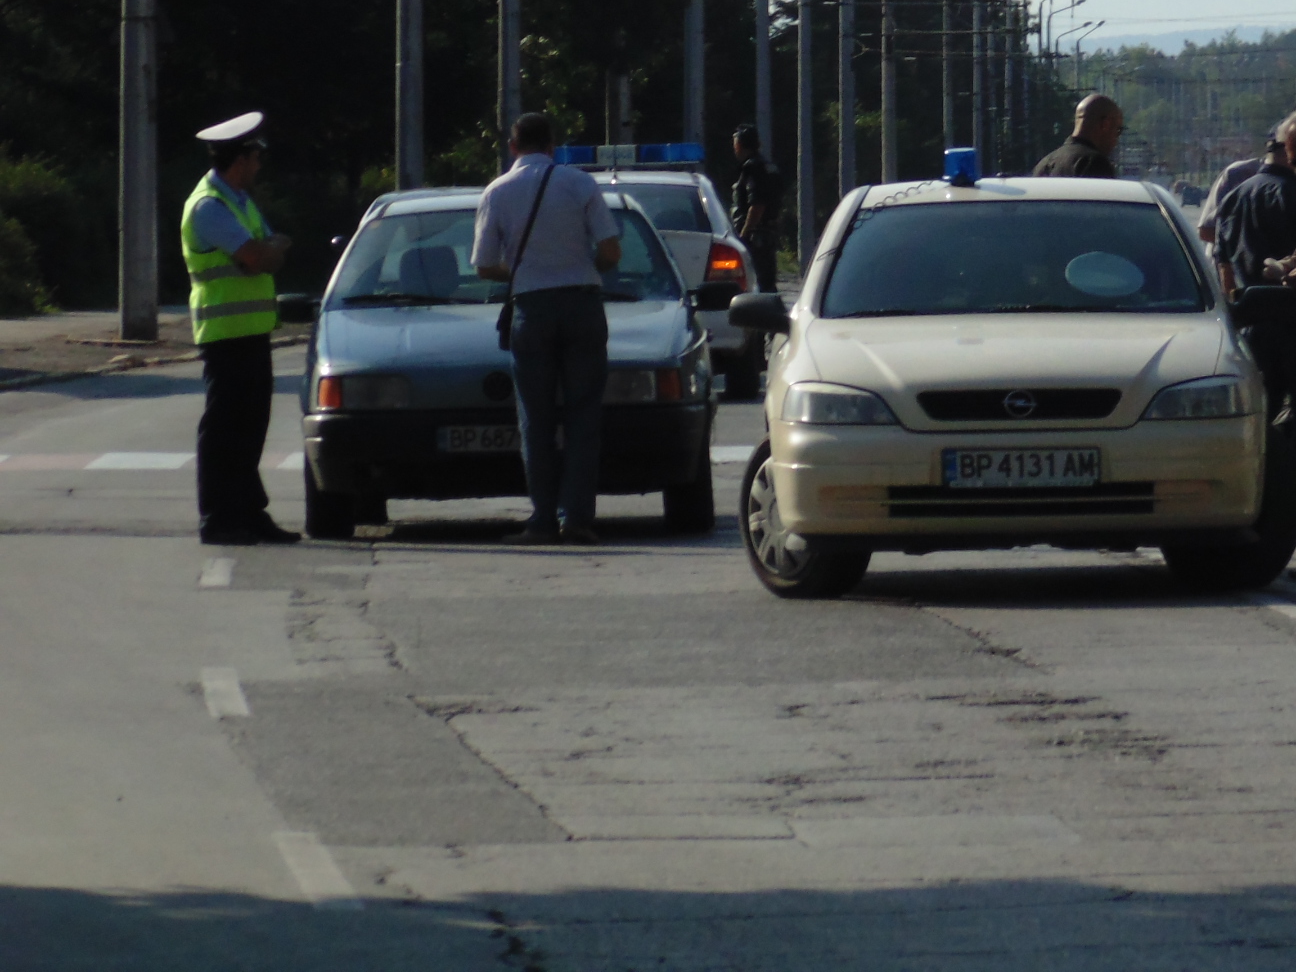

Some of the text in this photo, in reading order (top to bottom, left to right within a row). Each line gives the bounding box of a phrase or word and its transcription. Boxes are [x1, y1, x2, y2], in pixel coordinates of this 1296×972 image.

[481, 428, 517, 448] 687
[960, 452, 1095, 478] BP 4131 AM
